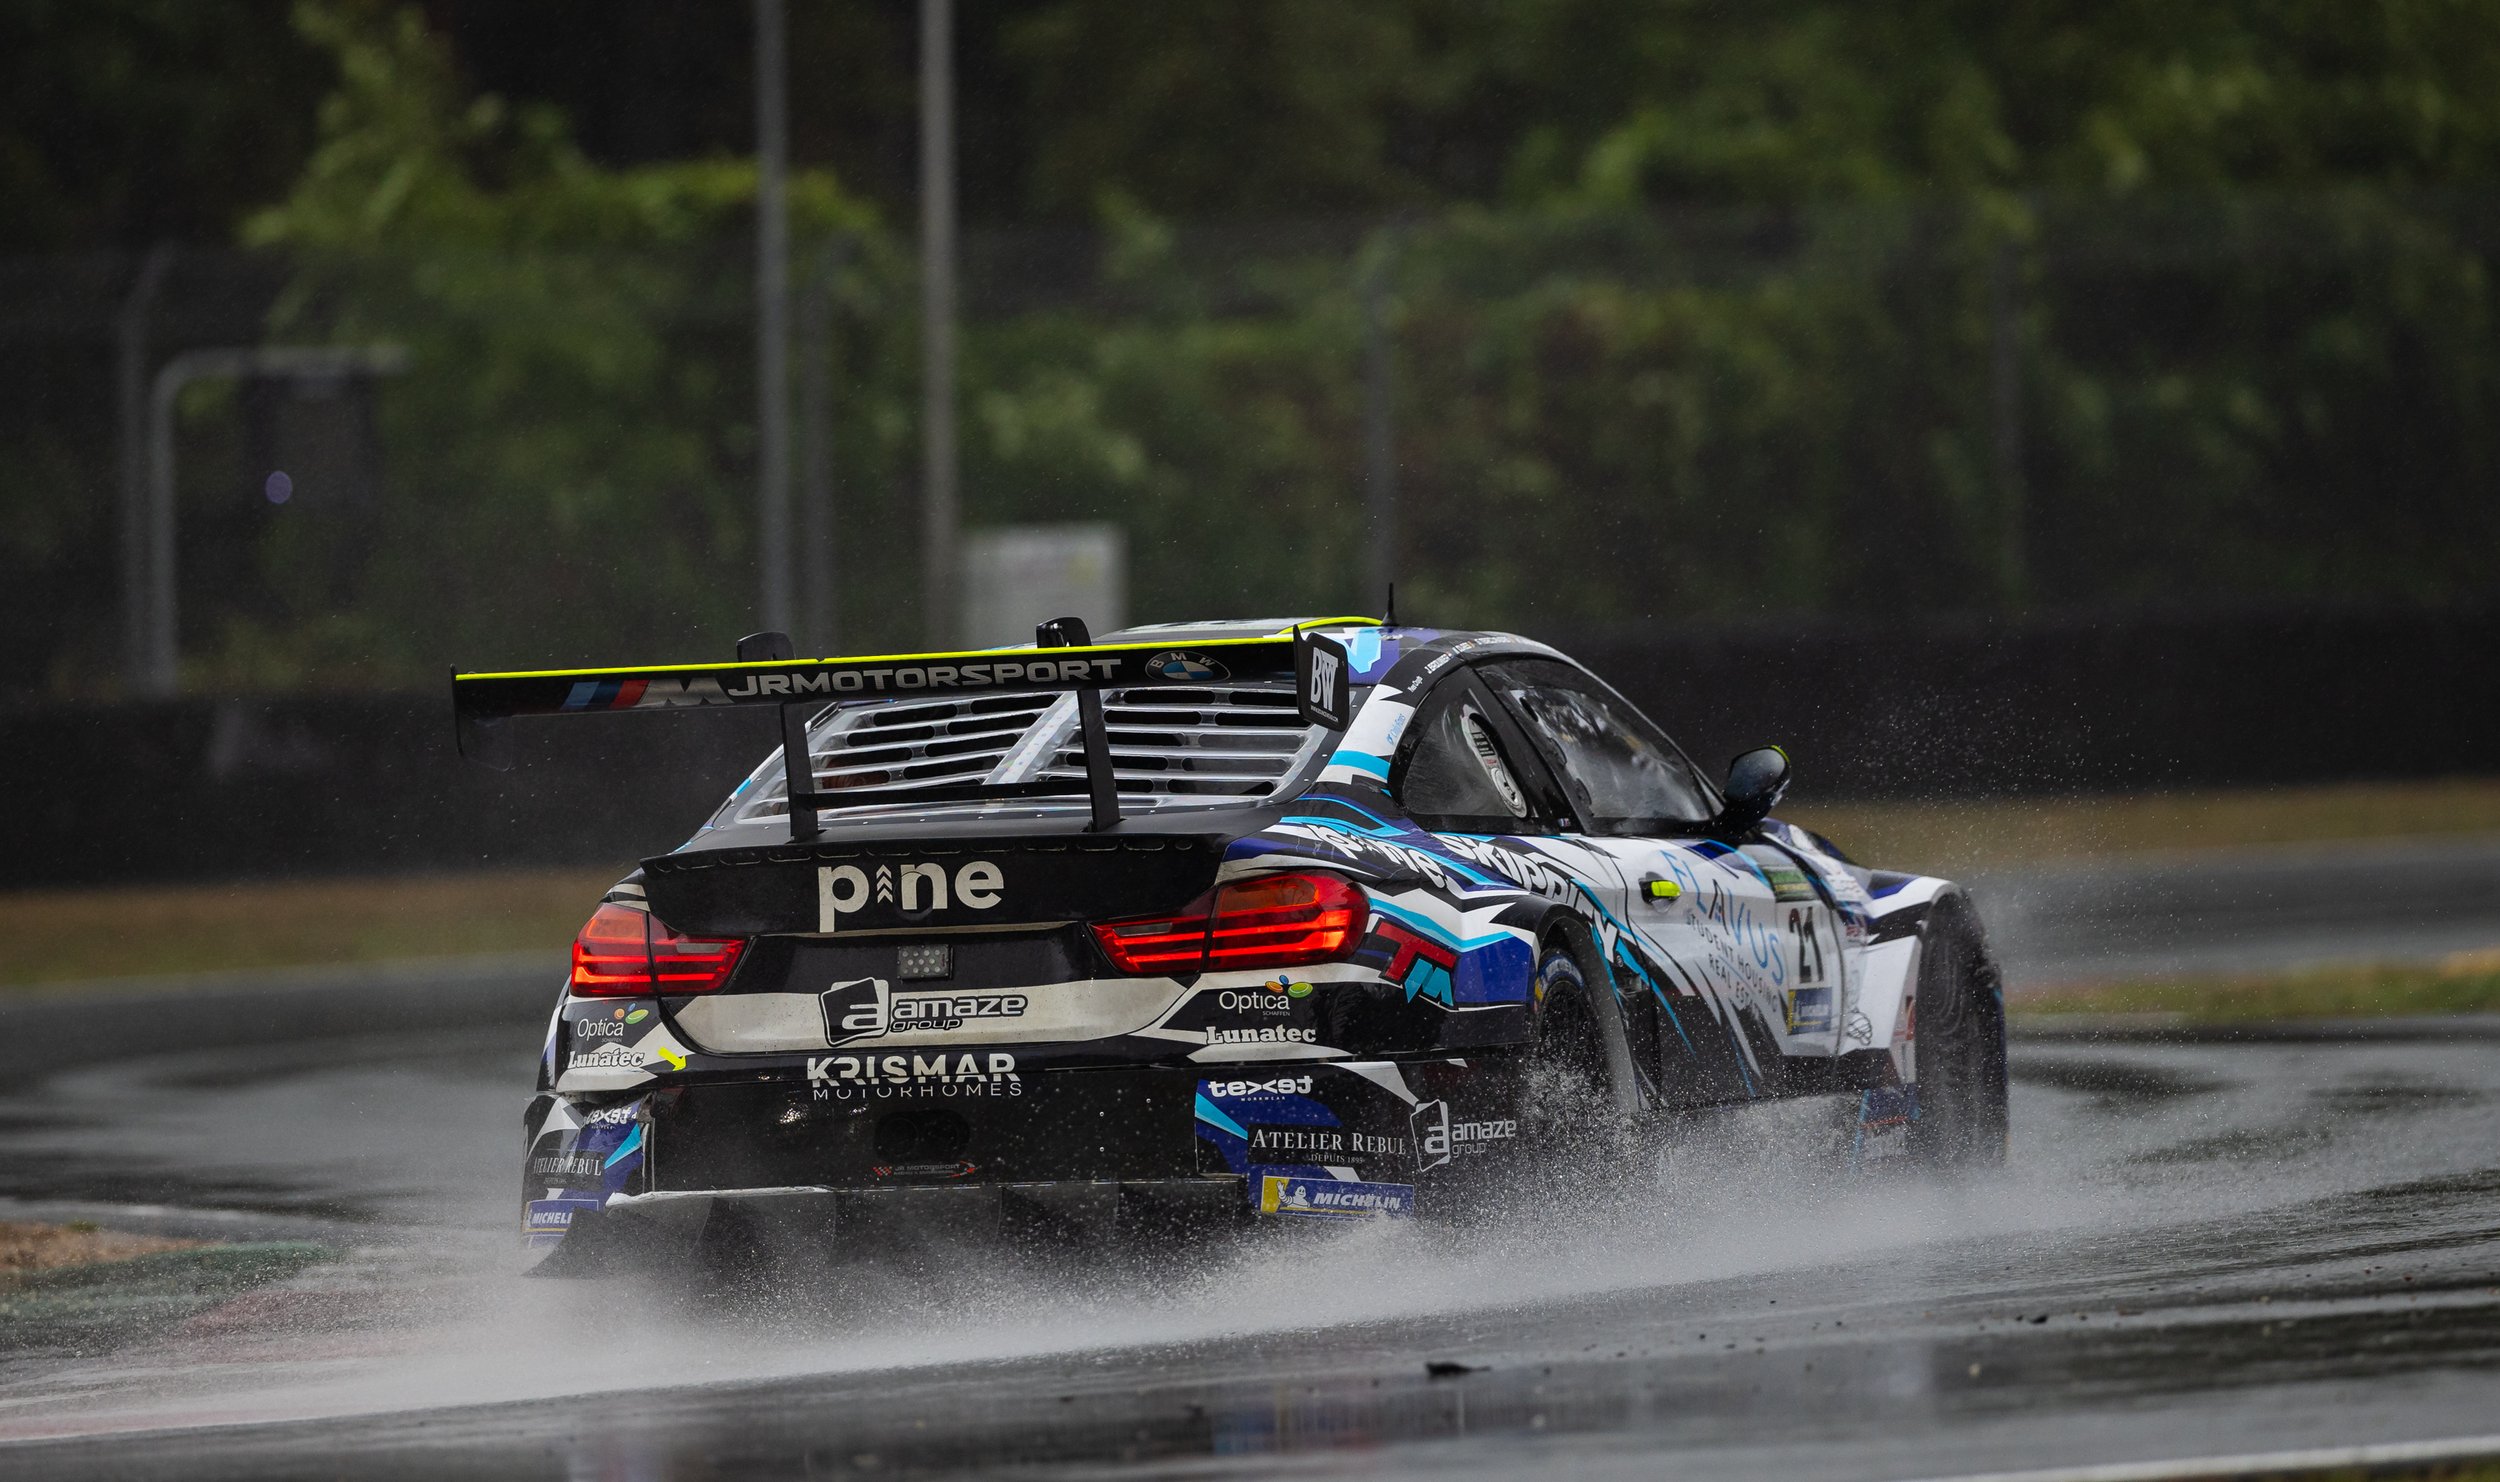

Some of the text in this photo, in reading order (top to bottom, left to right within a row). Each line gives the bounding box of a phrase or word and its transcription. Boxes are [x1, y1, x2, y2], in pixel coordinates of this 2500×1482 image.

[1661, 850, 1784, 987] FLAVUS
[1788, 906, 1825, 984] 21
[893, 997, 1027, 1019] amaze
[1219, 991, 1290, 1014] Optica
[577, 1018, 624, 1041] Optica
[892, 1019, 962, 1032] group
[1206, 1024, 1317, 1044] Lunatec
[567, 1048, 645, 1069] Lunatec
[807, 1053, 1021, 1088] KRISMAR
[1251, 1128, 1407, 1155] ATELIER REBUL
[1452, 1120, 1517, 1142] amaze
[1452, 1142, 1487, 1158] group
[1312, 1192, 1402, 1211] MICHELIN
